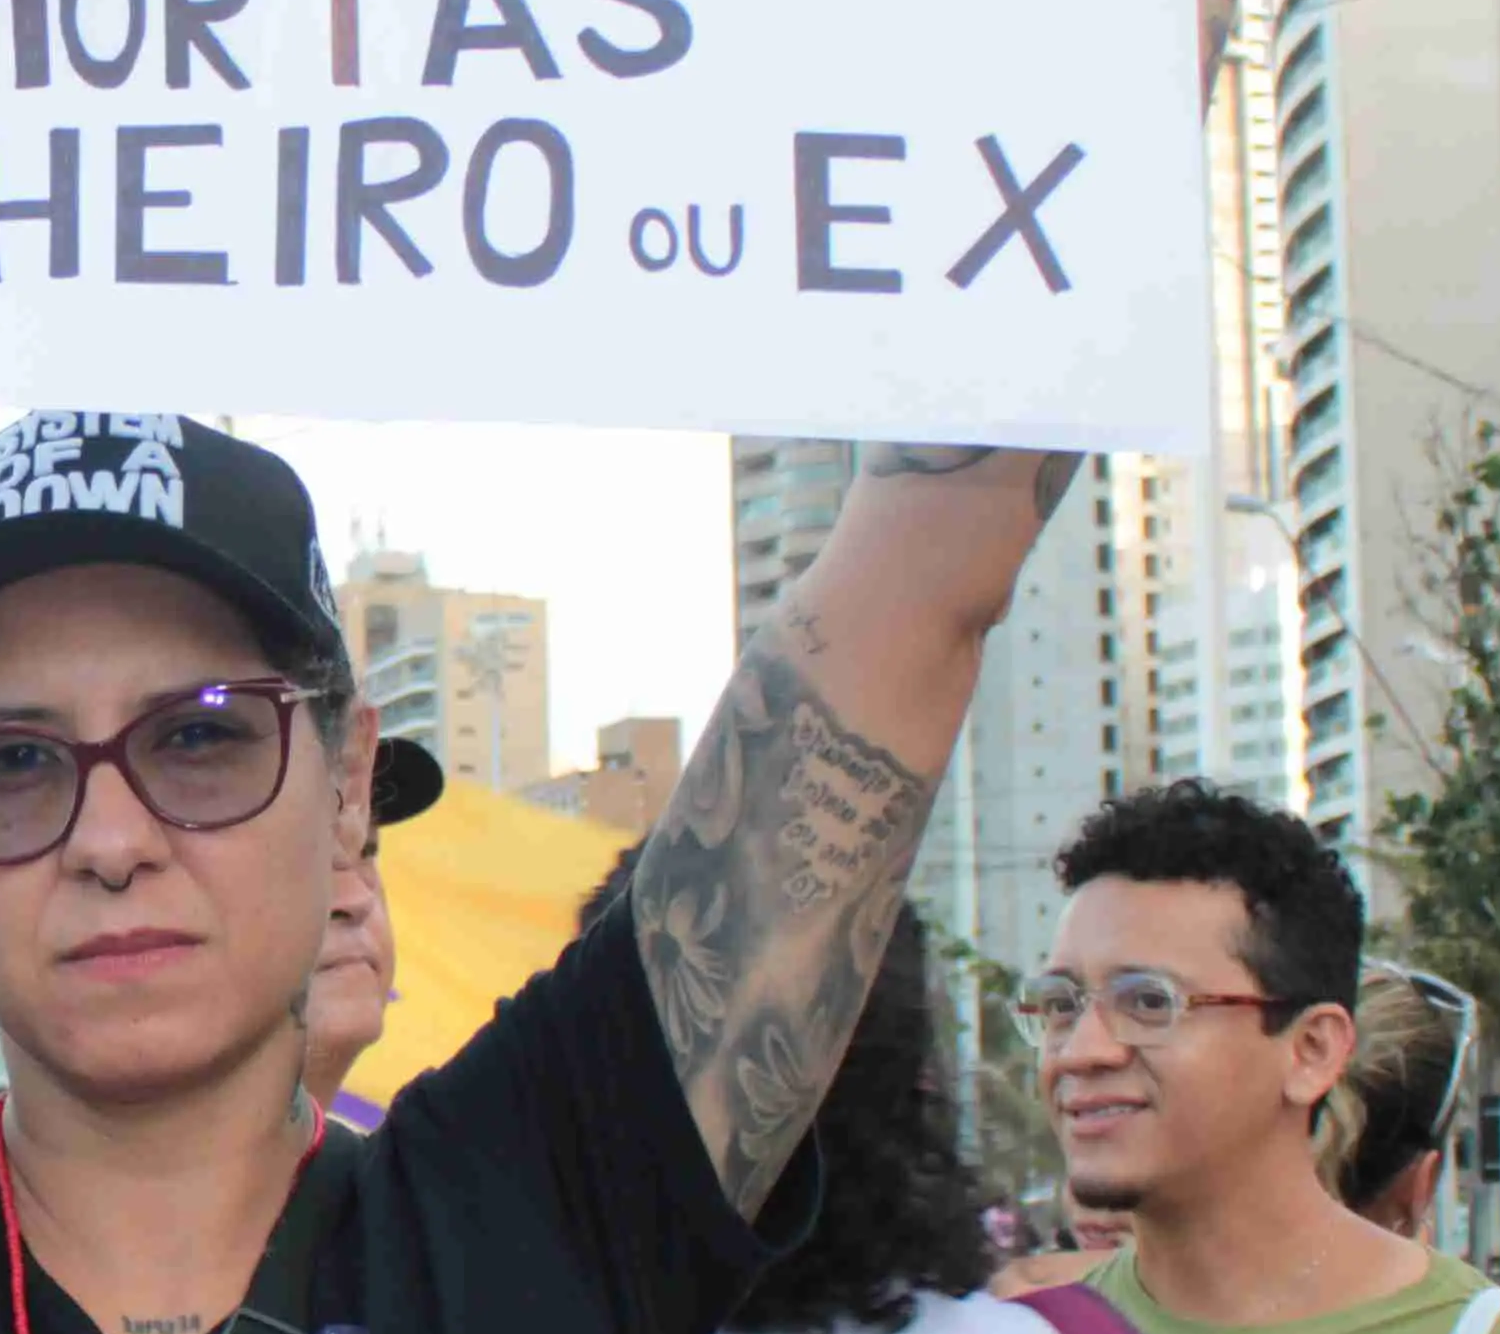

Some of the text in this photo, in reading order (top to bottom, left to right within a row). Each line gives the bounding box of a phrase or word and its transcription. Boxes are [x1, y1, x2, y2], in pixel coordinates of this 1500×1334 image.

[628, 203, 745, 277] OU
[792, 129, 1087, 294] EX
[120, 440, 182, 480] A
